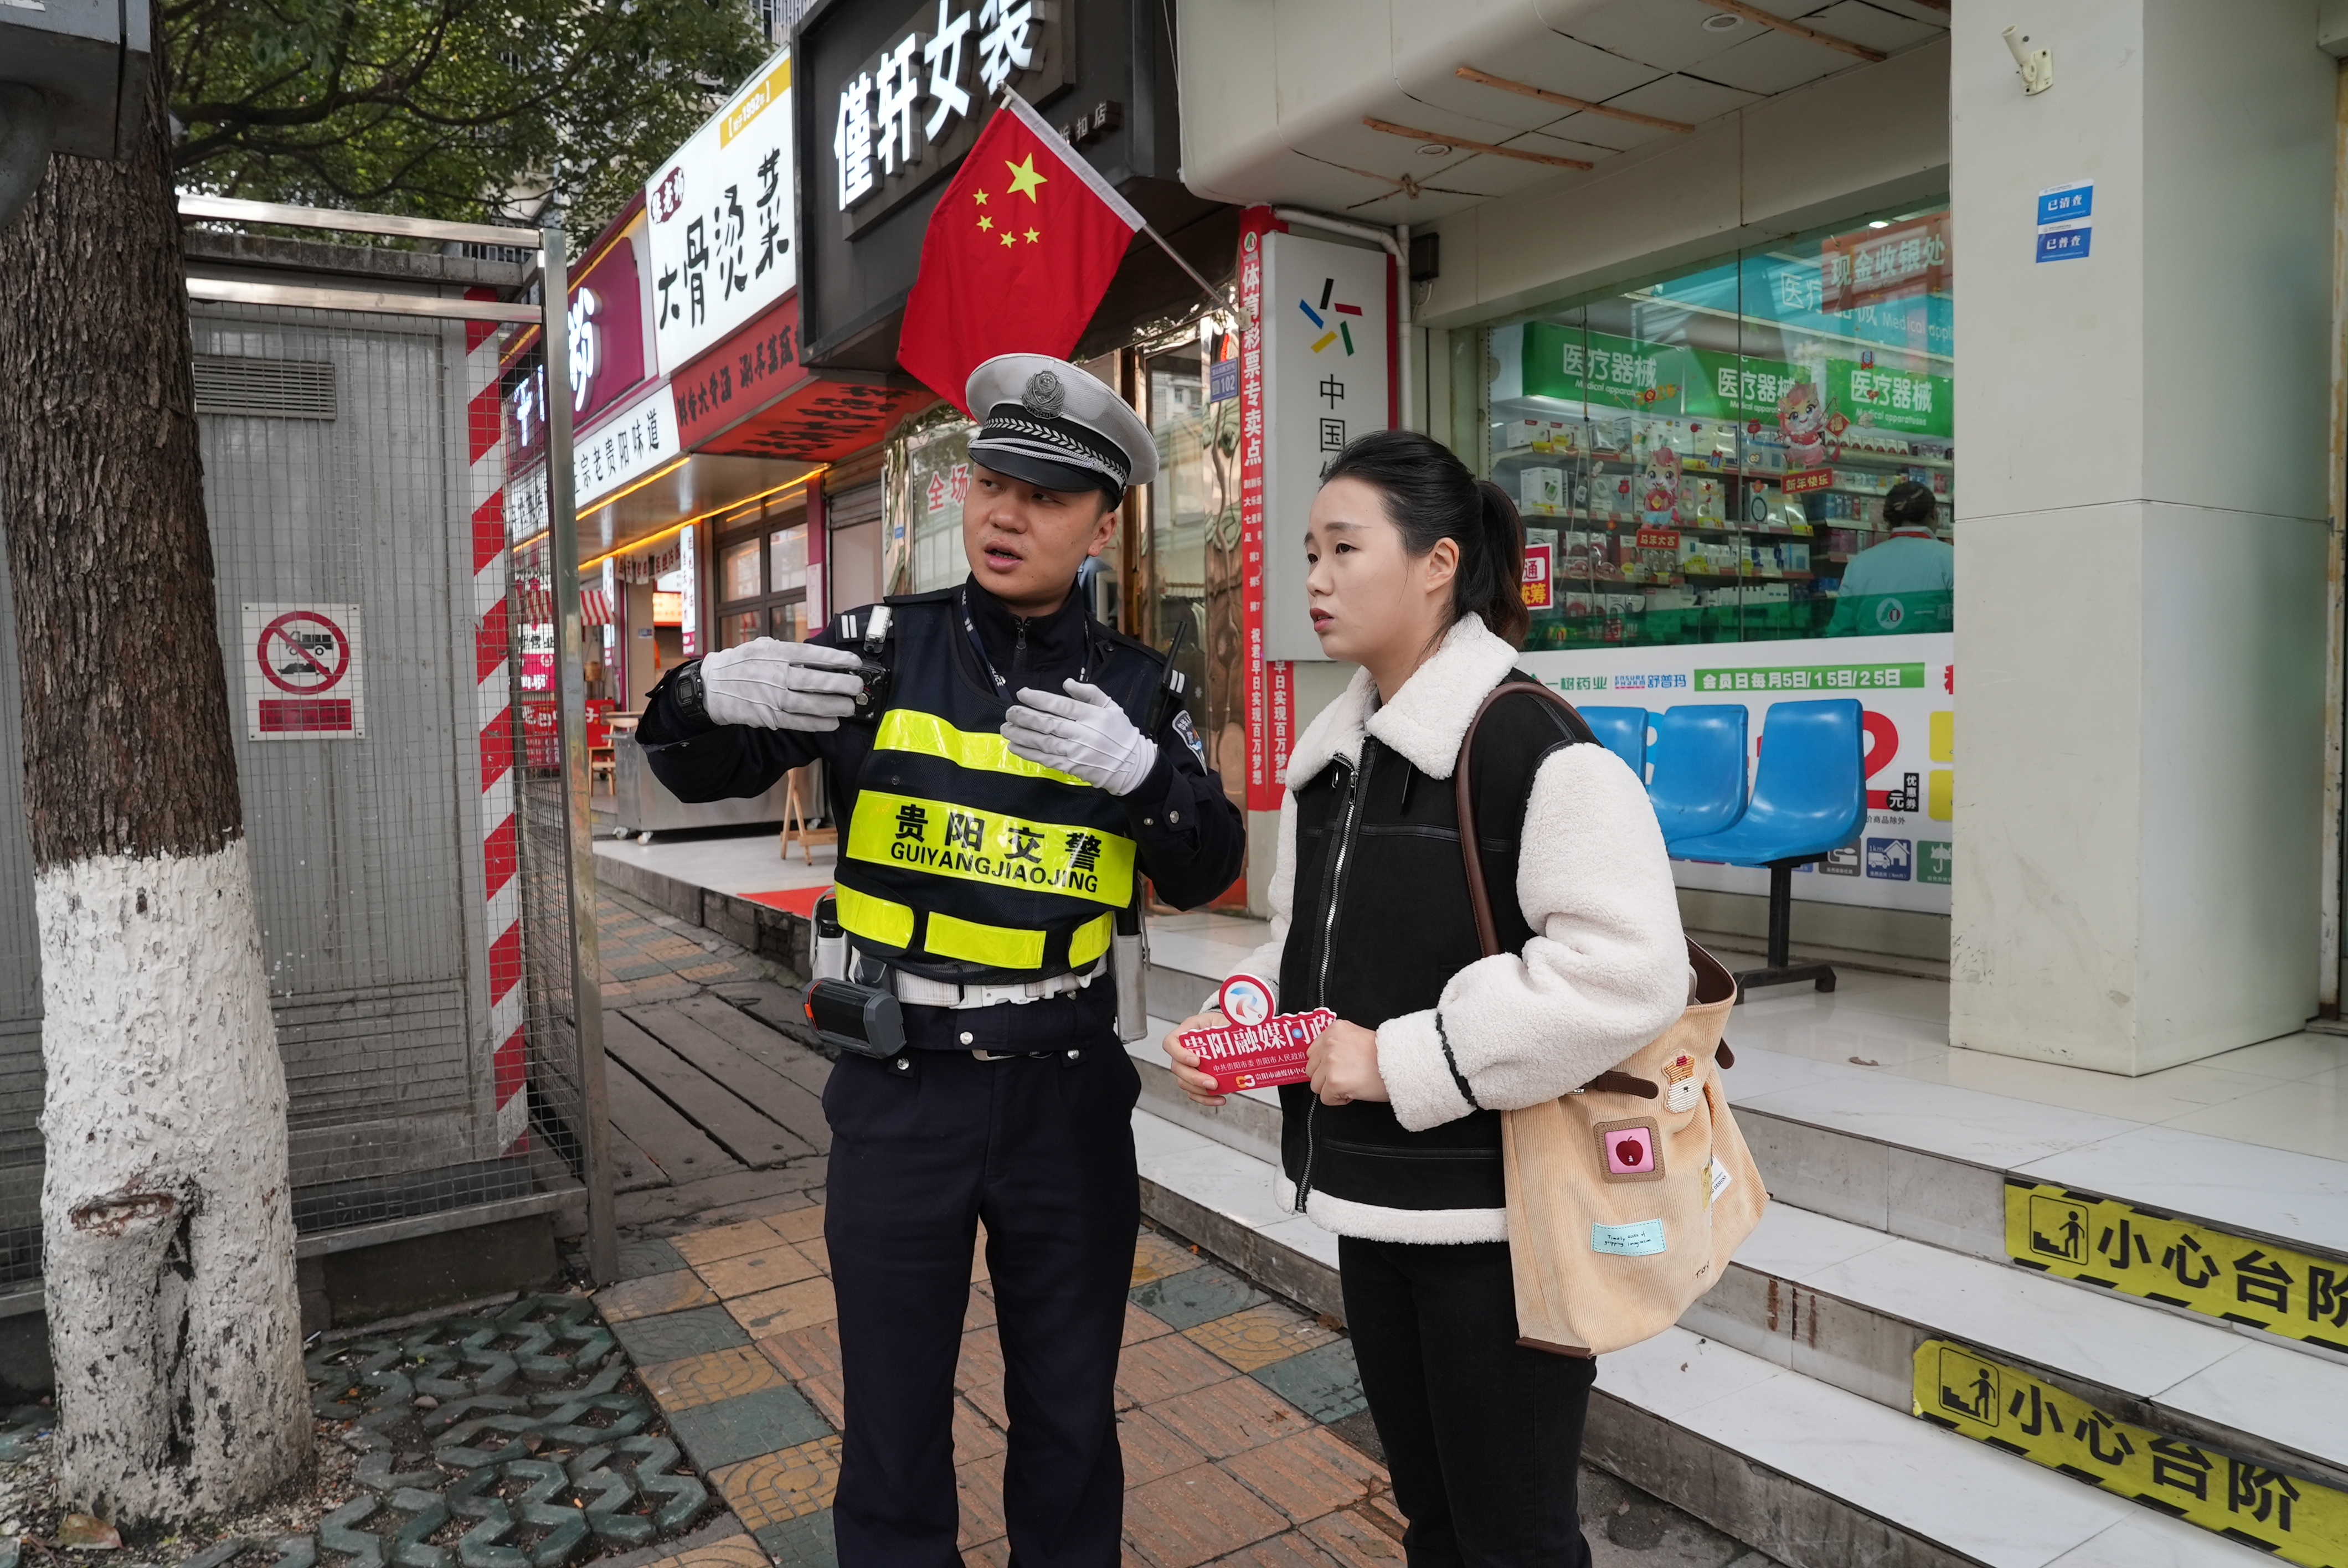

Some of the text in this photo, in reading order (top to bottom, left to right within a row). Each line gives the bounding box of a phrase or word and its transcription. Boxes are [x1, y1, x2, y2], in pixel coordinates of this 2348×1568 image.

[1830, 234, 1946, 288] 现金收银处
[1883, 313, 1925, 334] Medical
[1221, 374, 1235, 393] 102
[1242, 263, 1263, 466] 体育彩票专卖点
[1563, 343, 1657, 388] 医疗器械
[1718, 367, 1796, 403] 医疗器械
[1851, 370, 1933, 413] 医疗器械
[1320, 374, 1345, 478] 中国
[928, 464, 969, 512] 全场
[1785, 474, 1829, 489] 新年快乐
[1545, 677, 1607, 690] 一树药业
[1647, 674, 1686, 688] 舒普玛
[1251, 628, 1263, 785] 祝君早日实现百万梦想
[1889, 793, 1904, 808] 元
[1906, 775, 1917, 809] 优惠券
[895, 804, 1102, 873] 贵阳交警
[890, 842, 1098, 893] GUIYANGJIAOJING
[1213, 1051, 1306, 1072] 中共贵阳市委 贵阳市人民政府
[1255, 1066, 1306, 1080] 贵阳市融媒体中心
[2008, 1384, 2301, 1532] 小心台阶
